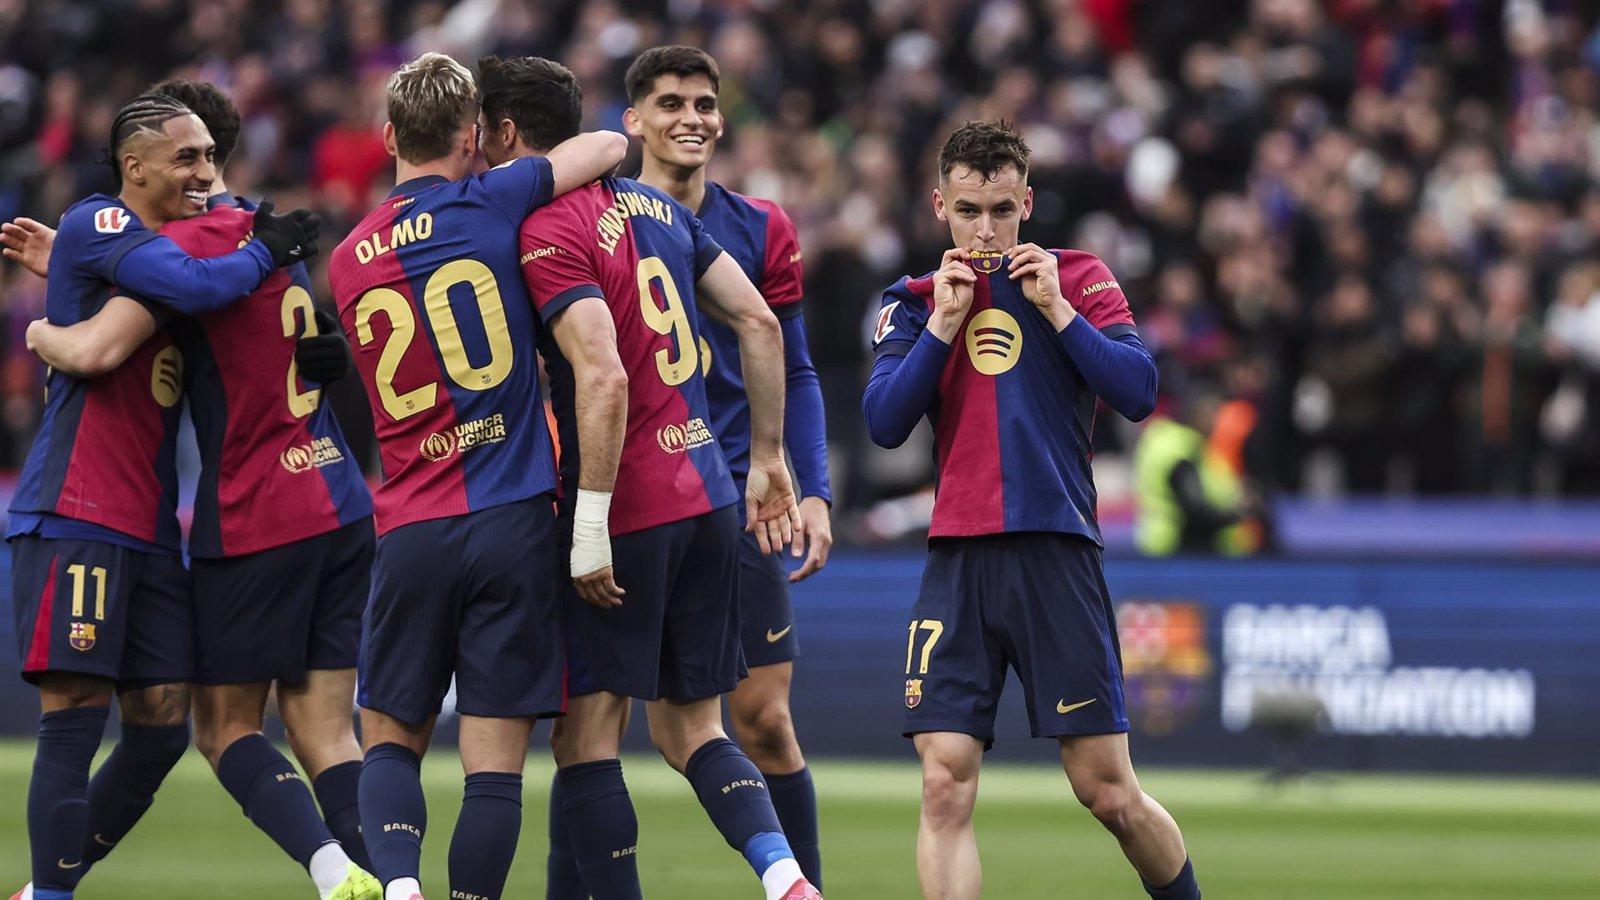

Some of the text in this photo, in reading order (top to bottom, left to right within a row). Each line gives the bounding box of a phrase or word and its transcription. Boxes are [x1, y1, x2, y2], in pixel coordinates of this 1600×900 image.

[355, 213, 433, 265] OLMO
[355, 258, 514, 421] 20
[636, 256, 698, 386] 9
[454, 413, 504, 437] UNHCR
[457, 424, 506, 449] ACNUR
[66, 563, 107, 620] 11
[905, 619, 944, 674] 17
